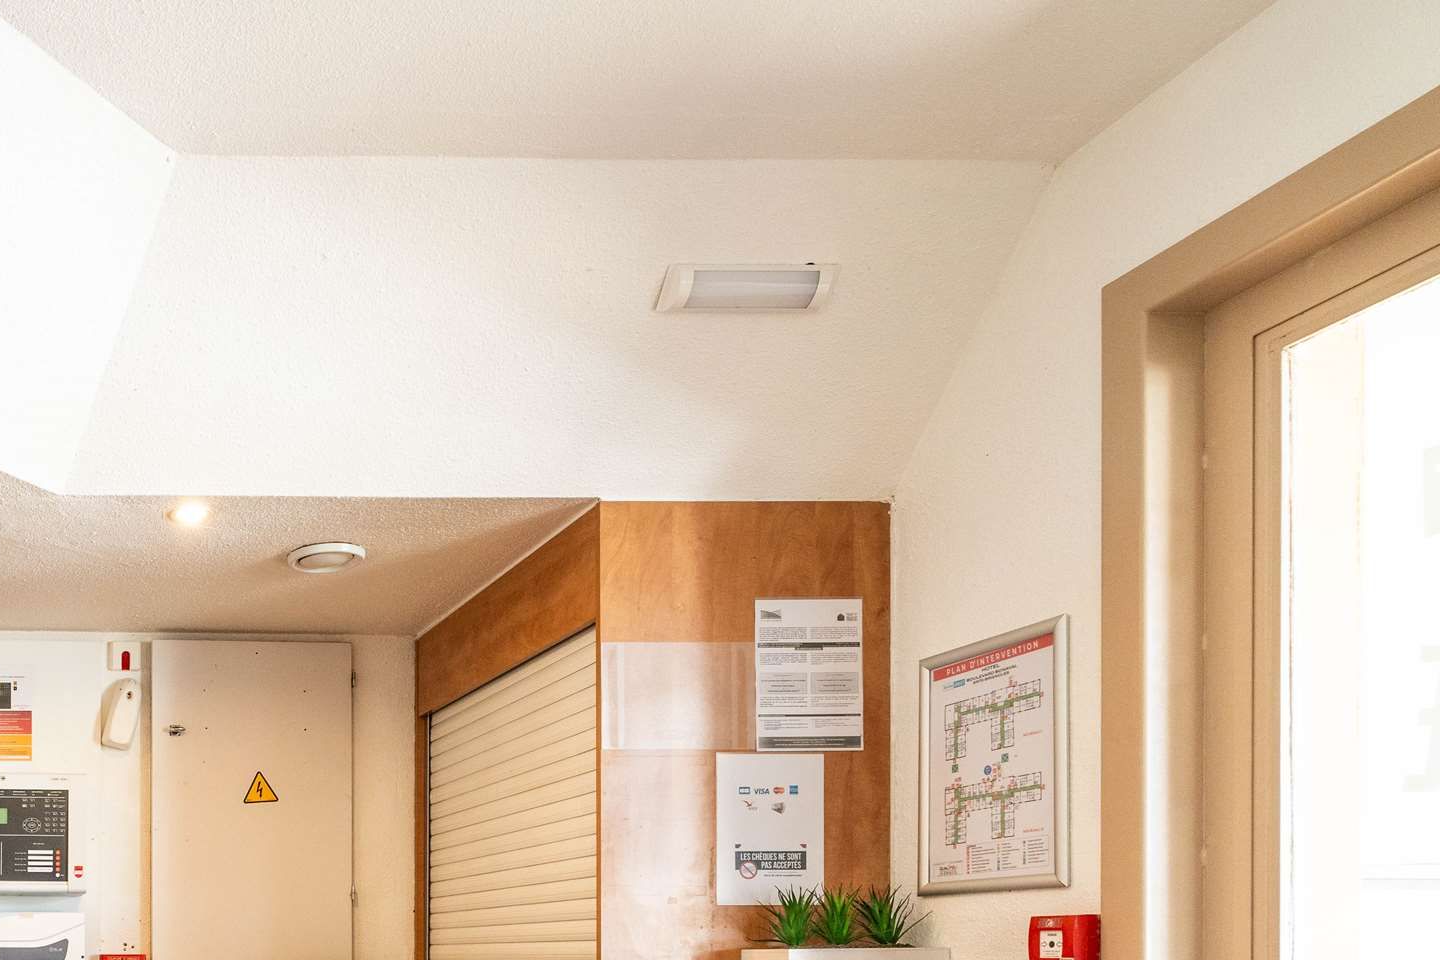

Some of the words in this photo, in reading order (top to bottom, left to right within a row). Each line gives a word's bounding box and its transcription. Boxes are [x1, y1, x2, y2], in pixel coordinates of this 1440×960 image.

[945, 663, 967, 676] PLAN
[968, 641, 1040, 668] D'INTERVENTION
[740, 852, 751, 861] LES
[778, 852, 787, 861] NE
[787, 852, 802, 861] SONT
[761, 861, 772, 869] PAS
